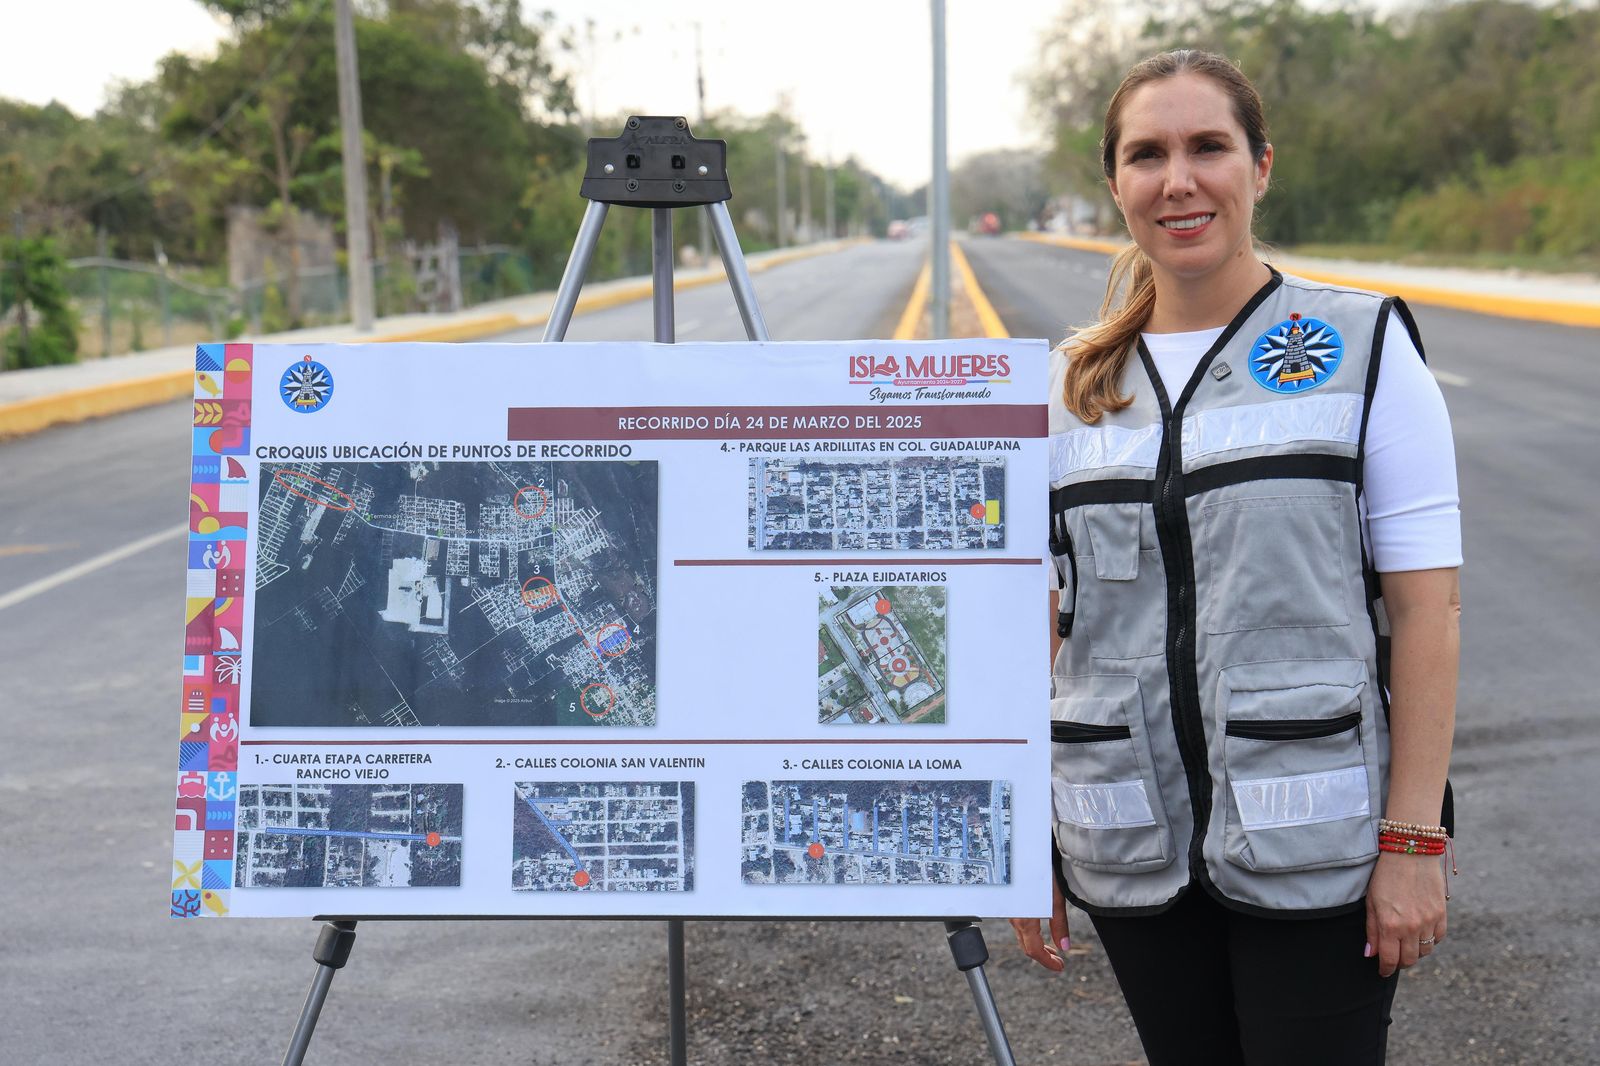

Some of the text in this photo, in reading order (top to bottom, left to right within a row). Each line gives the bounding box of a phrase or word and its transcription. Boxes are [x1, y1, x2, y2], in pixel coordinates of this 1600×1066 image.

[849, 354, 1011, 378] ISLA MUJERES
[869, 387, 992, 403] Sigamos Transformando
[618, 412, 922, 430] RECORRIDO DÍA 24 DE MARZO DEL 2025
[255, 441, 632, 460] CROQUIS UBICACIÓN DE PUNTOS DE RECORRIDO
[720, 440, 1021, 453] 4.- PARQUE LAS ARDILLITAS EN COL. GUADALUPANA
[538, 477, 545, 488] 2
[533, 564, 541, 575] 3
[814, 571, 947, 583] 5.- PLAZA EJIDATARIOS
[633, 625, 640, 636] 4
[568, 702, 576, 713] 5
[255, 753, 432, 765] 1.- CUARTA ETAPA CARRETERA
[495, 757, 705, 769] 2.- CALLES COLONIA SAN VALENTIN
[782, 759, 962, 770] 3.- CALLES COLONIA LA LOMA
[296, 768, 390, 780] RANCHO VIEJO
